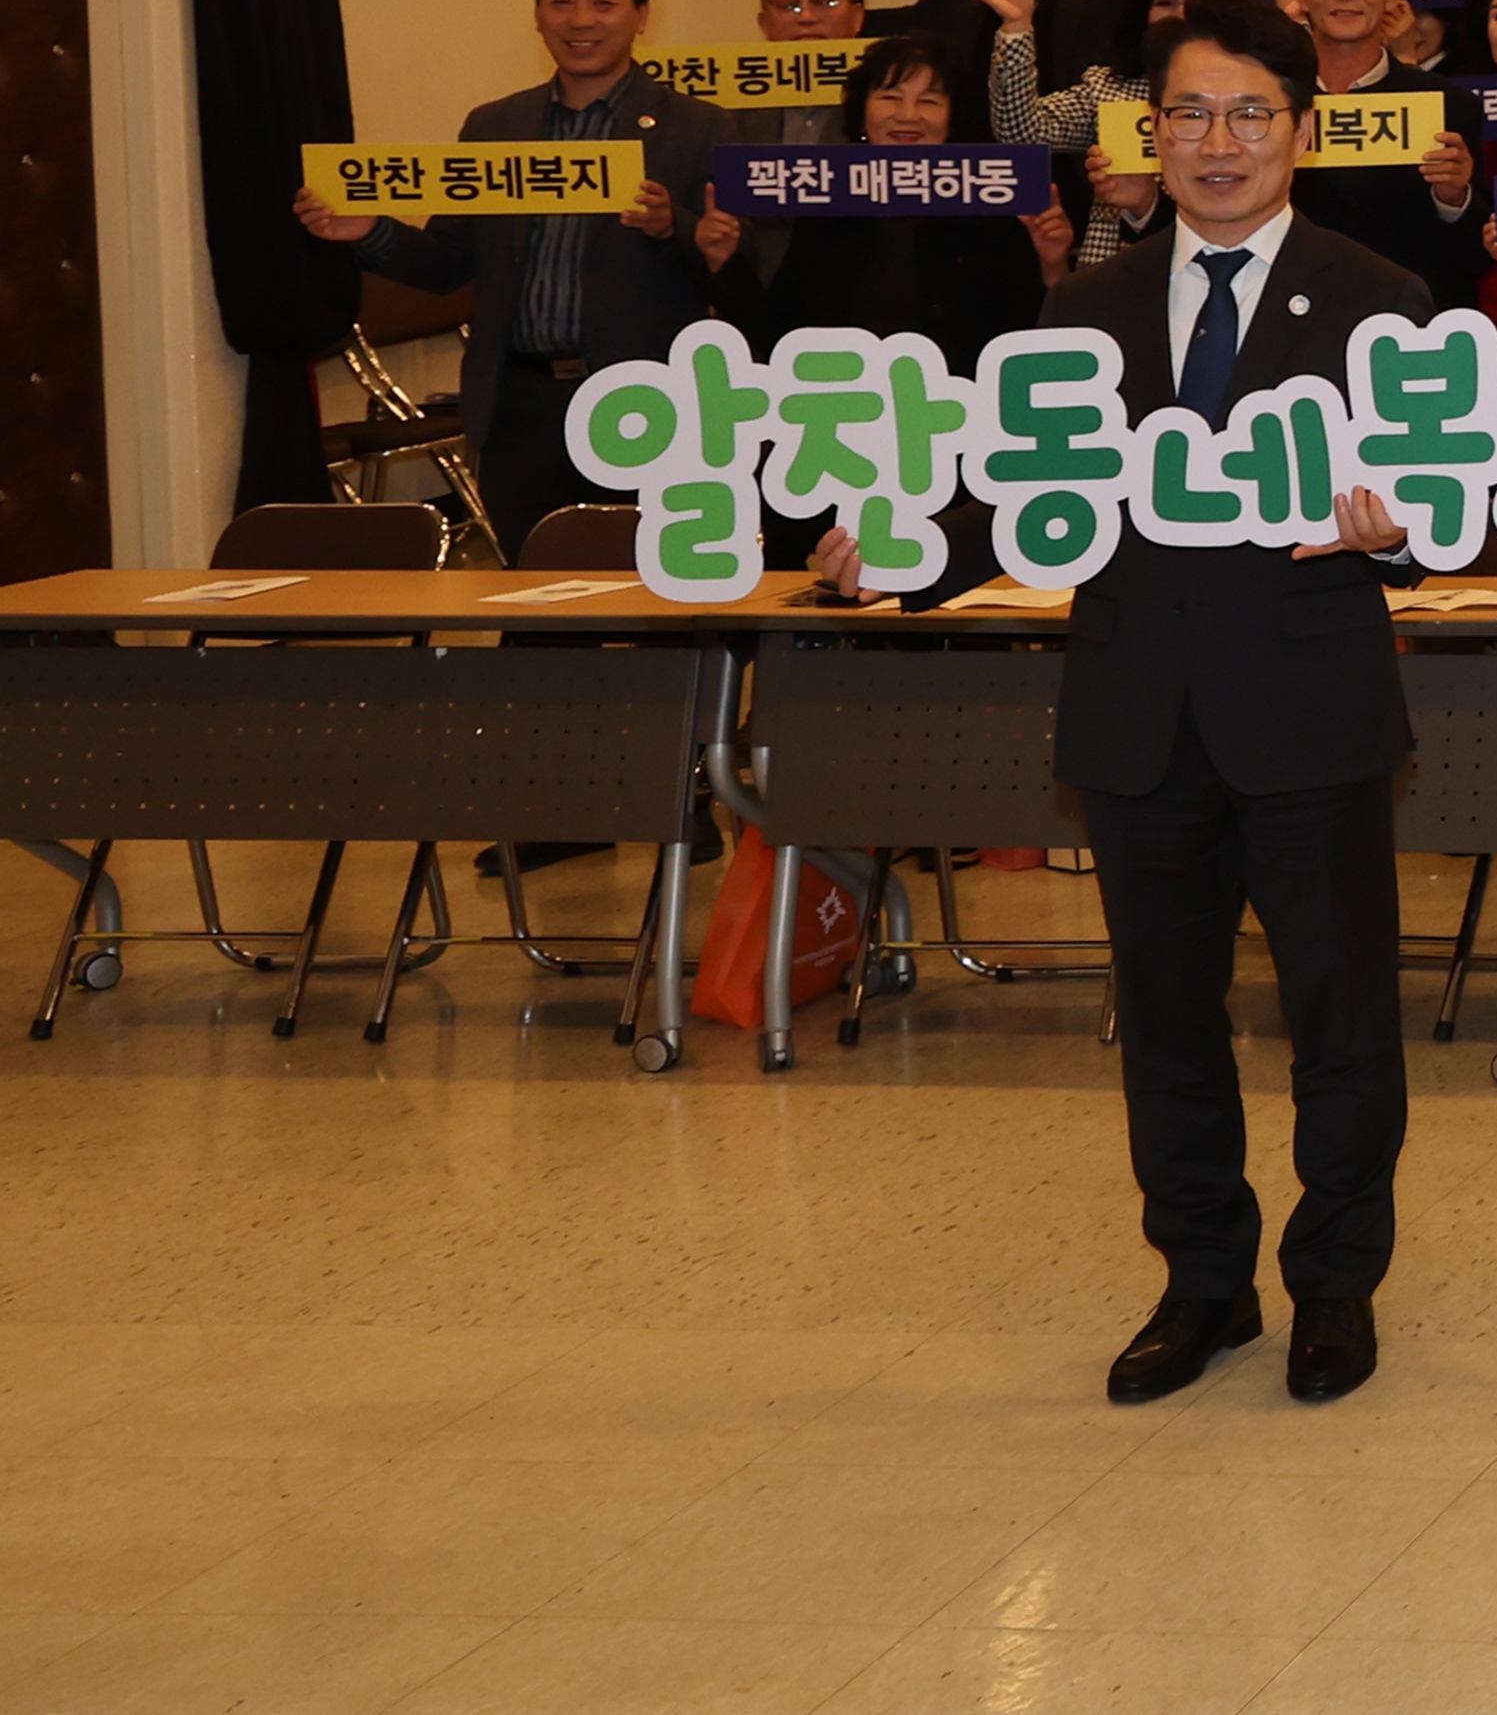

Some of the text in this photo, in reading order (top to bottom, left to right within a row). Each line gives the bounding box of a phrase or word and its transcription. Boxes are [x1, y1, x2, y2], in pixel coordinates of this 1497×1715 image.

[733, 53, 866, 96] 동네복
[338, 155, 610, 202] 알찬 동네복지
[746, 158, 1019, 205] 꽉찬 매력하동
